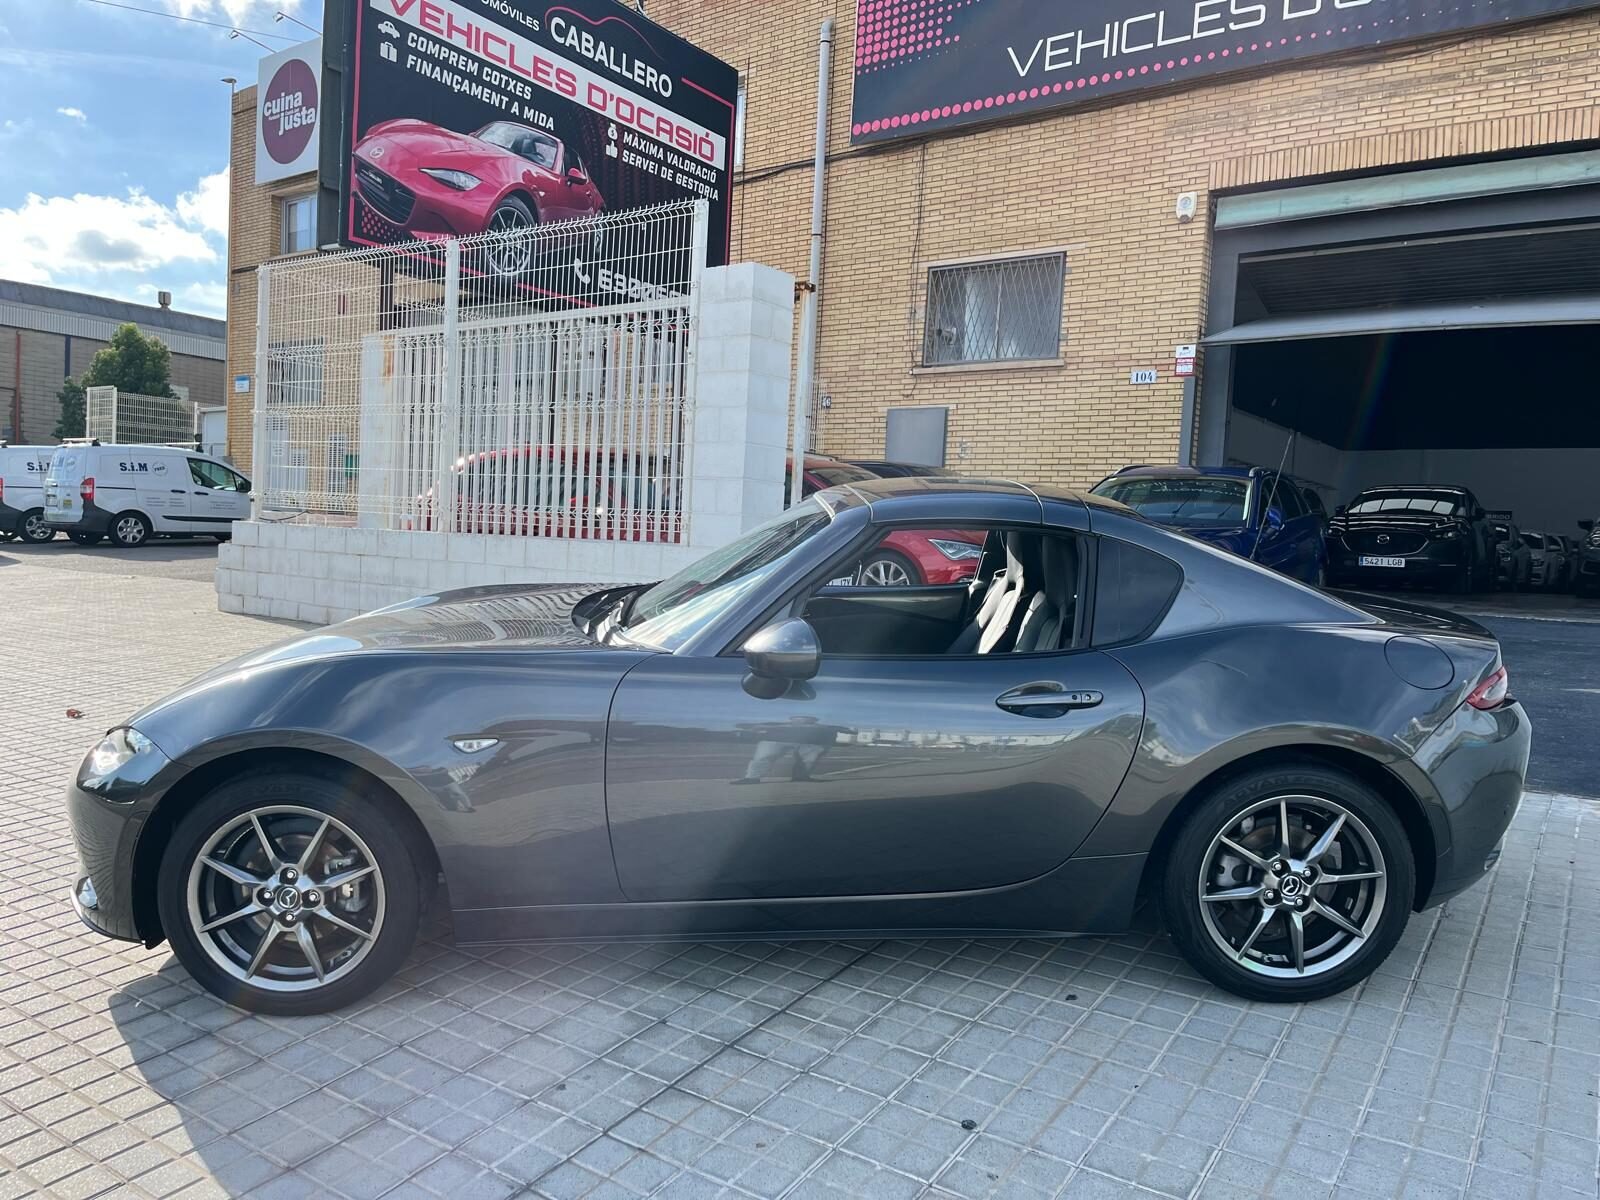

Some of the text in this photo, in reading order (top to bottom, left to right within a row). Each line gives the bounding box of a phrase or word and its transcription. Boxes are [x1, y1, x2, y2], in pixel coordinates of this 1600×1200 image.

[550, 16, 673, 98] CABALLERO
[1007, 0, 1266, 77] VEHICLES
[389, 0, 715, 162] VEHICLES D'OCASIÓ
[407, 32, 532, 100] COMPREM COTXES
[264, 91, 302, 117] cuina
[406, 54, 555, 131] FINANÇAMENT A MIDA
[279, 106, 316, 136] justa
[622, 149, 719, 201] SERVEI DE GESTORIA
[623, 131, 717, 184] MÀXIMA VALORACIÓ
[1135, 371, 1153, 382] 104
[119, 462, 148, 472] S.i.M
[1364, 557, 1384, 566] 5421
